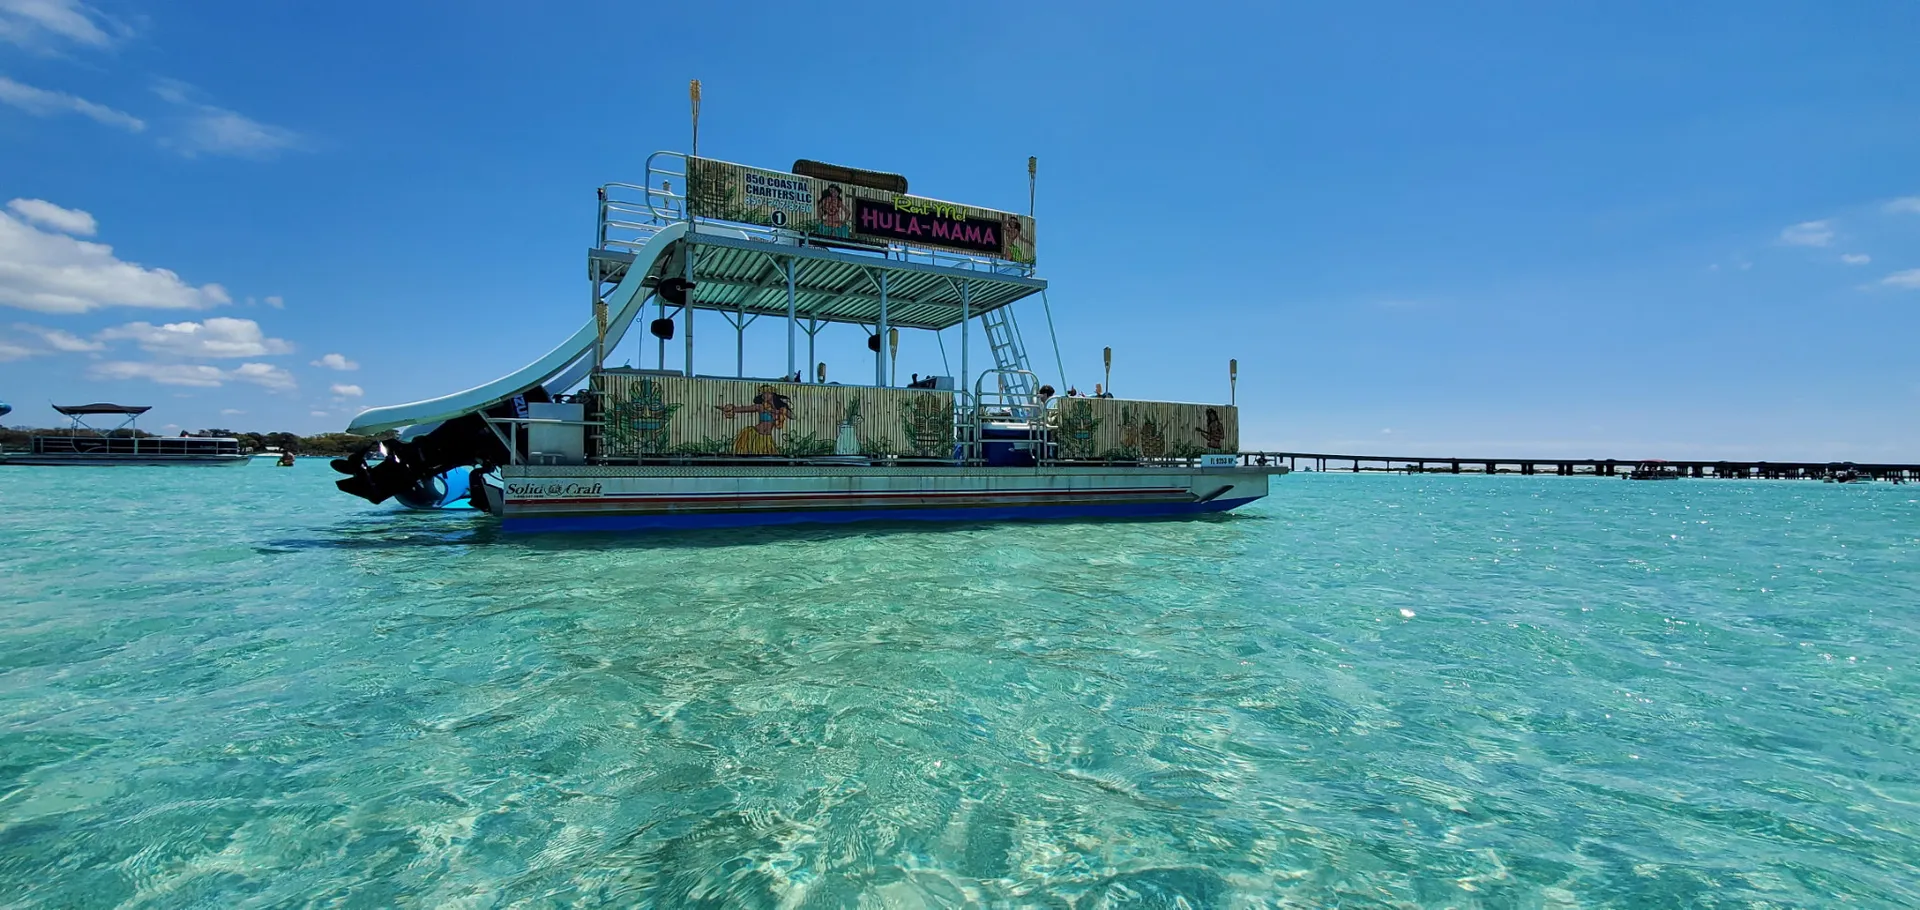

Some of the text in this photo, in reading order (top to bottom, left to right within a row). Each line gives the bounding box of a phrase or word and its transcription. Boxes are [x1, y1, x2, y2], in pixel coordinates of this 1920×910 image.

[746, 173, 808, 192] 850 COASTAL
[746, 184, 812, 203] CHARTERS LLC
[893, 197, 967, 222] Rent Me!
[861, 207, 997, 245] HULA-MAMA
[506, 482, 602, 494] Solid Craft
